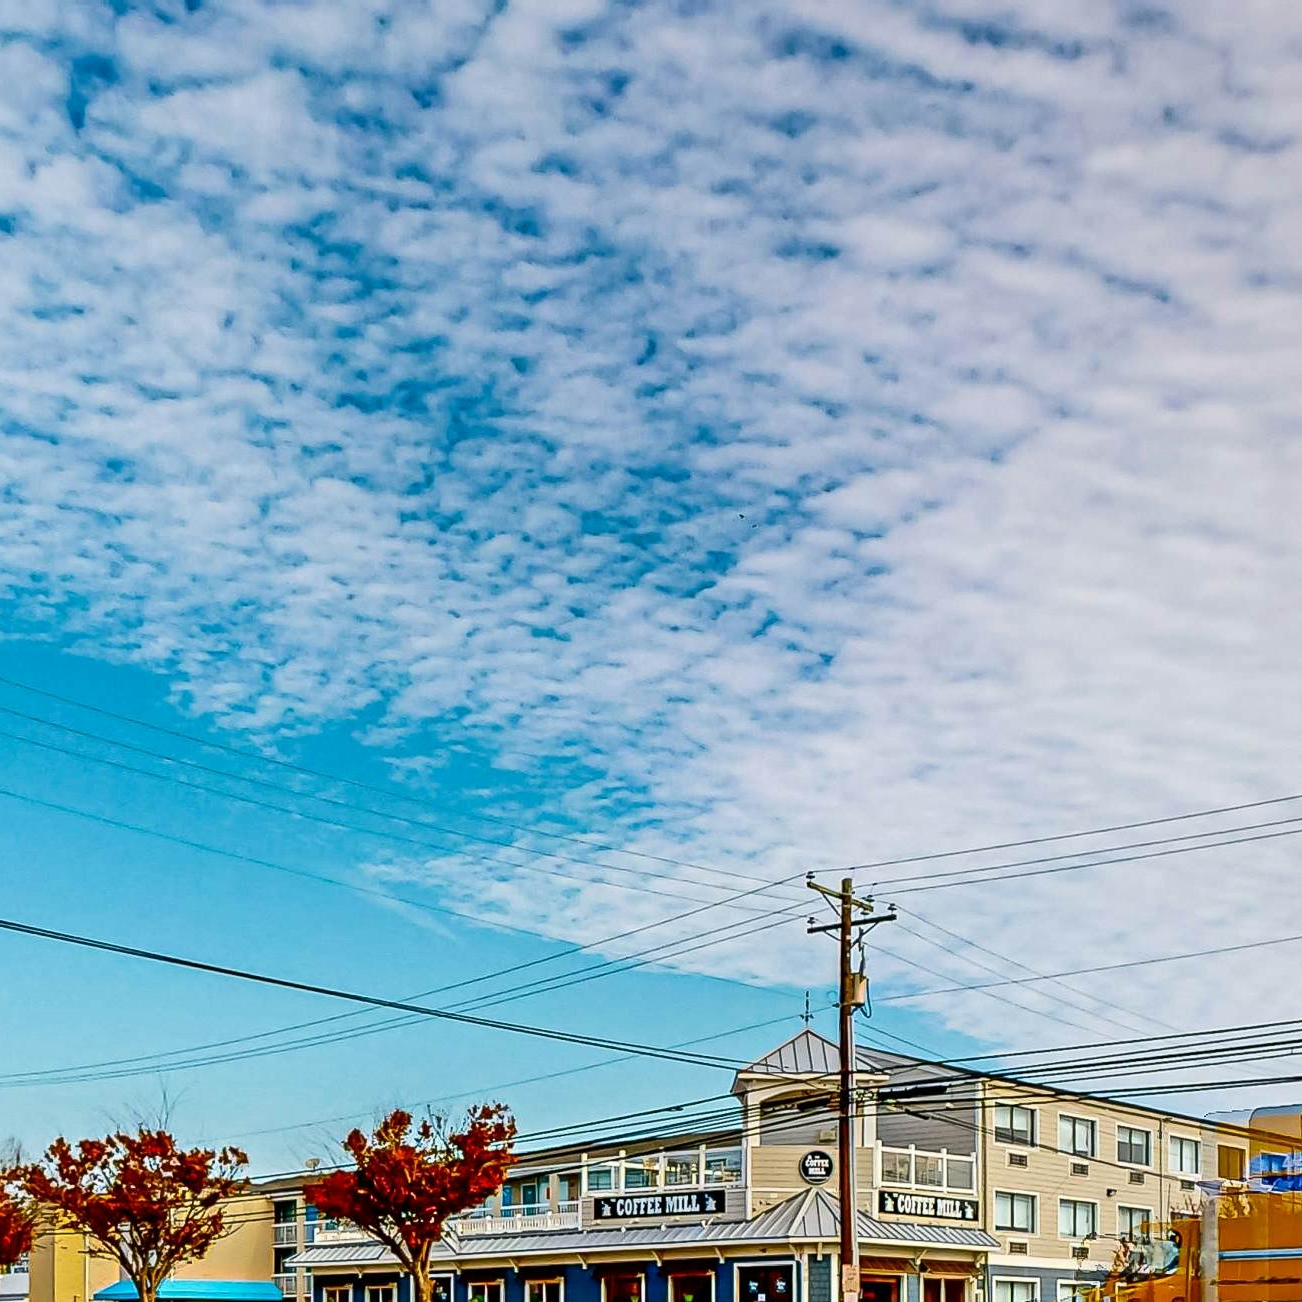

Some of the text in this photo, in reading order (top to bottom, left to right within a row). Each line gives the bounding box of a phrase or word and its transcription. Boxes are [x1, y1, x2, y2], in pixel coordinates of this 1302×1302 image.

[617, 1195, 700, 1216] COFFEE MILL
[898, 1194, 962, 1219] COFFEE MILL
